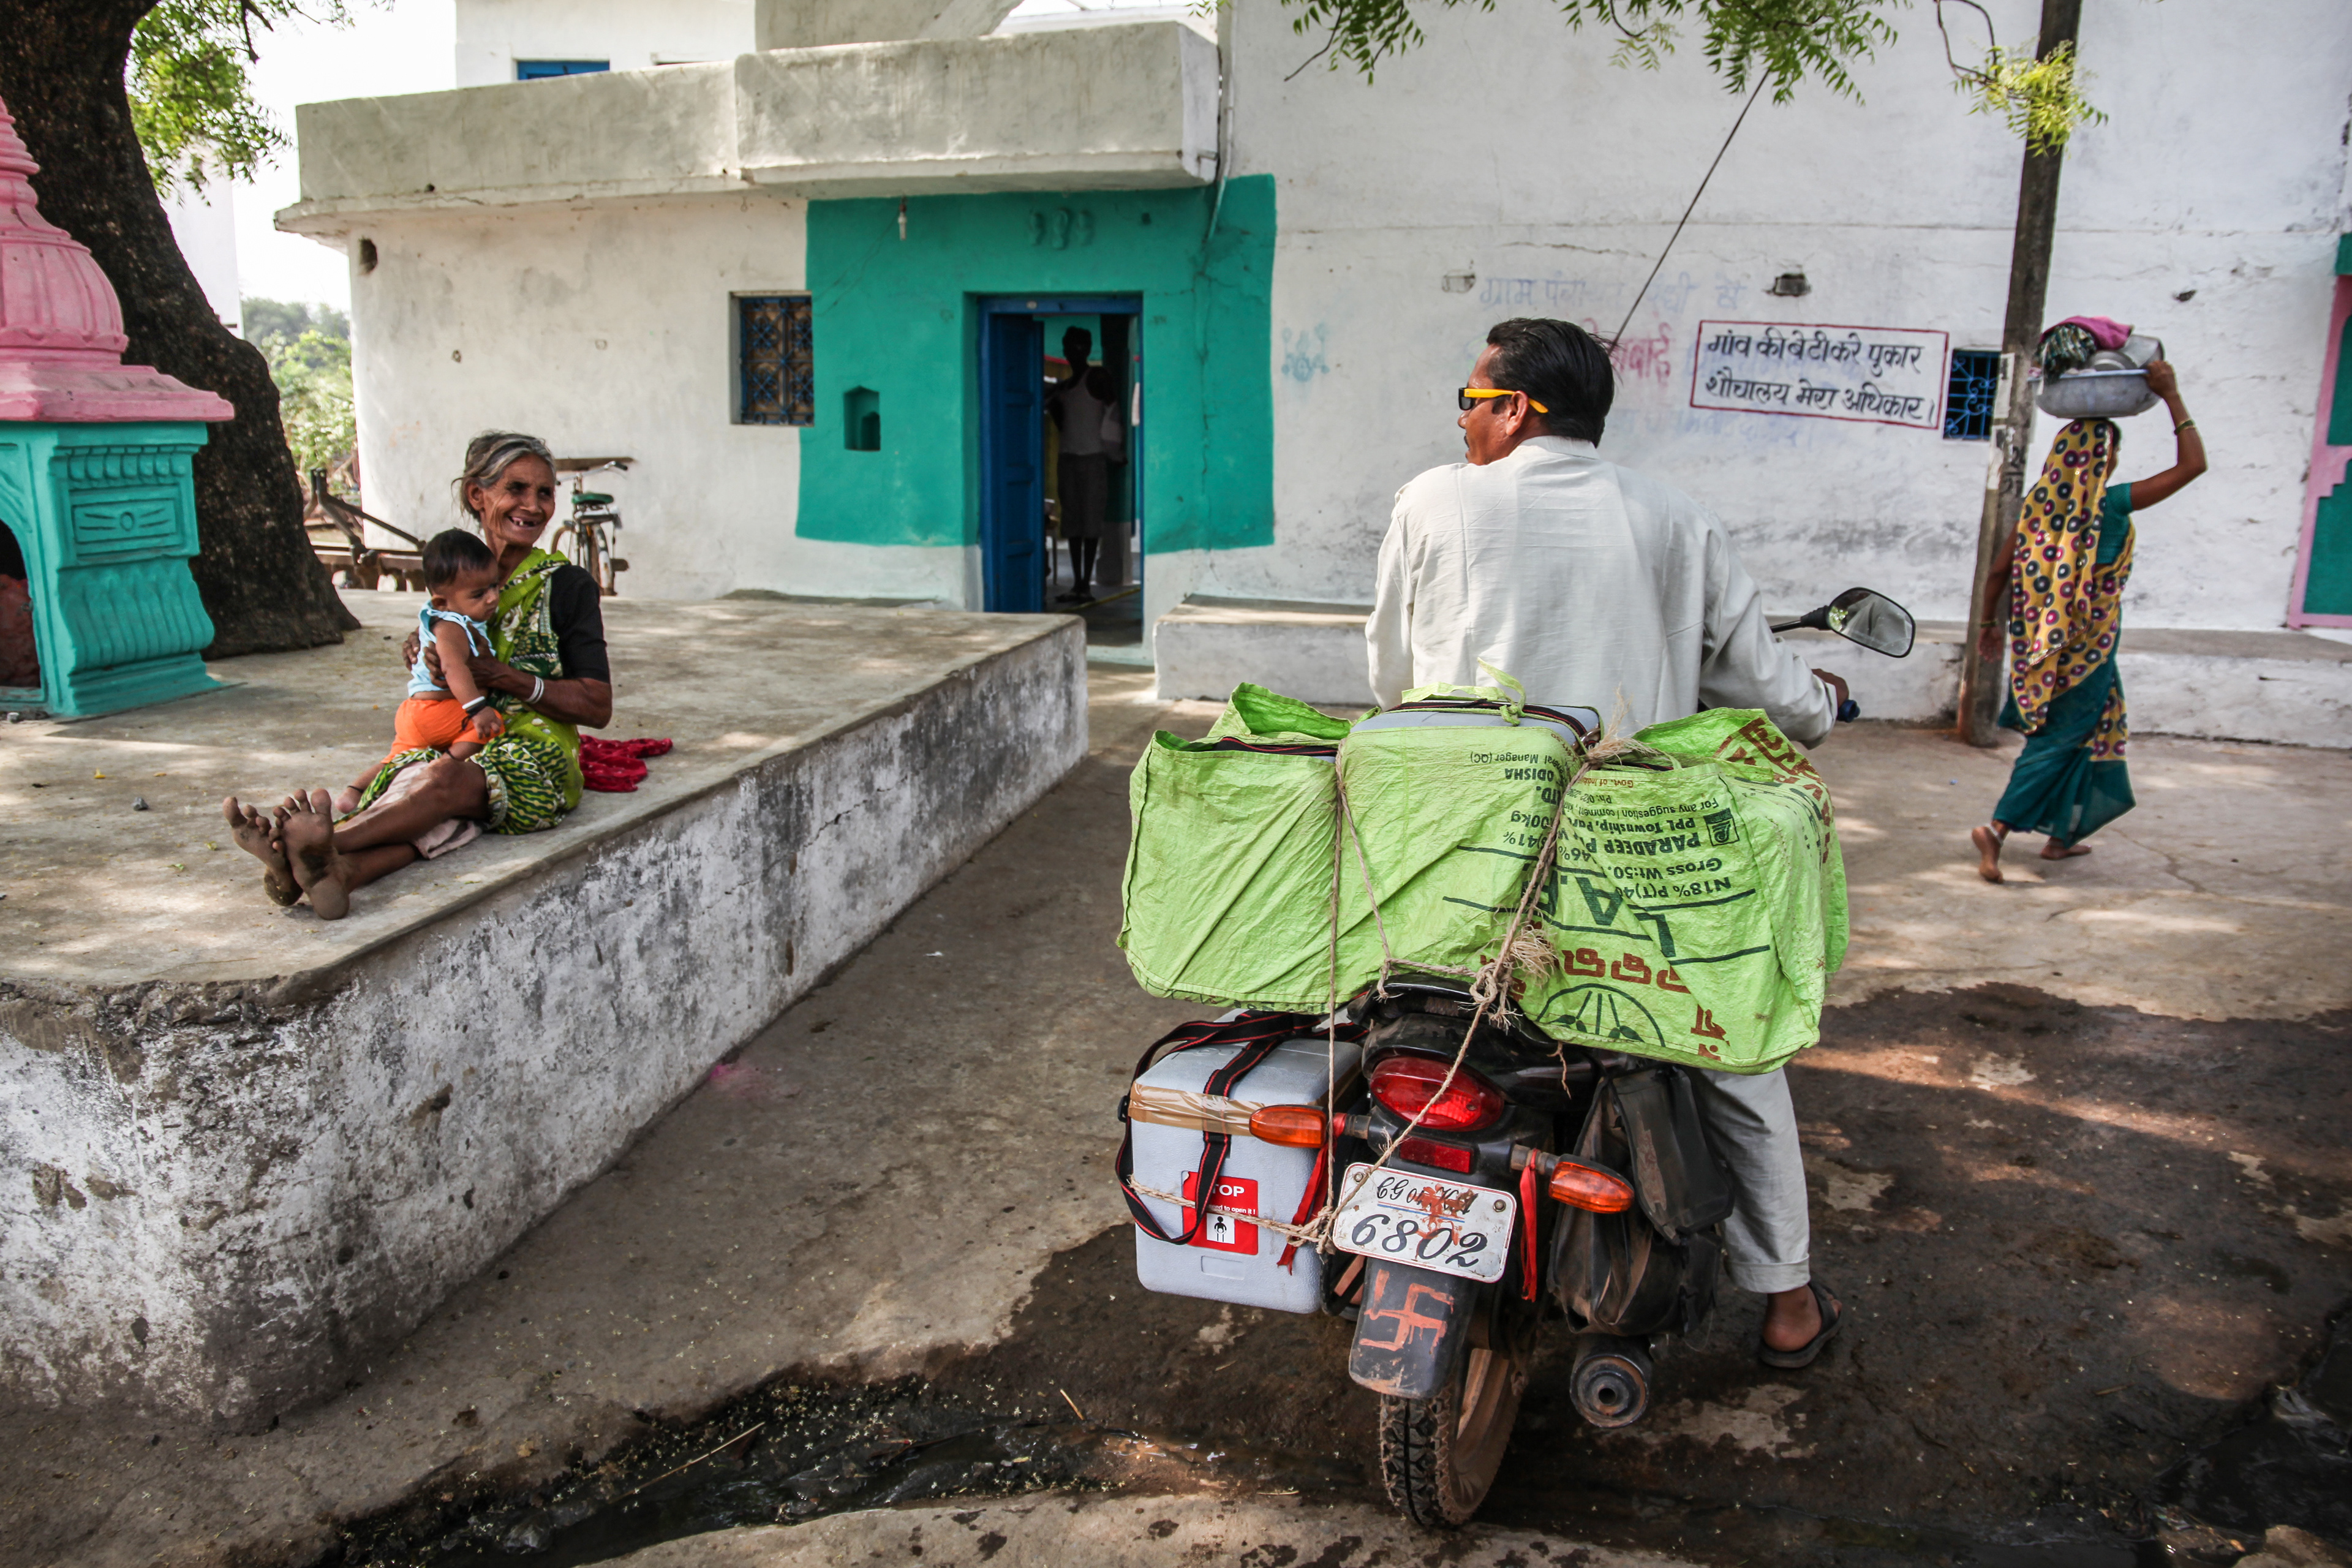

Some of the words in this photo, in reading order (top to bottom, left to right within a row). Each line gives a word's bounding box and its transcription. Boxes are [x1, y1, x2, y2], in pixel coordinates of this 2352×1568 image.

[1708, 330, 1752, 358] गांव
[1756, 326, 1785, 360] की
[1787, 330, 1830, 363] बेटी
[1830, 332, 1862, 365] करे
[1869, 344, 1924, 378] पुकार
[1706, 366, 1791, 405] शौचालय
[1796, 378, 1840, 410] मेरा
[1842, 382, 1925, 419] अधिकार
[1470, 752, 1493, 764] (QC)
[1495, 752, 1539, 764] Manager
[1504, 768, 1555, 782] ODISHA
[1611, 779, 1634, 788] Govt.
[1679, 803, 1697, 815] any
[1701, 798, 1719, 811] For
[1622, 805, 1676, 820] suggestion
[1595, 820, 1664, 835] Township,
[1666, 818, 1695, 831] PPL
[1604, 832, 1702, 857] PARADEEP
[1666, 858, 1722, 877] Gross
[1673, 876, 1732, 898] N18%
[1351, 1213, 1488, 1268] 6802
